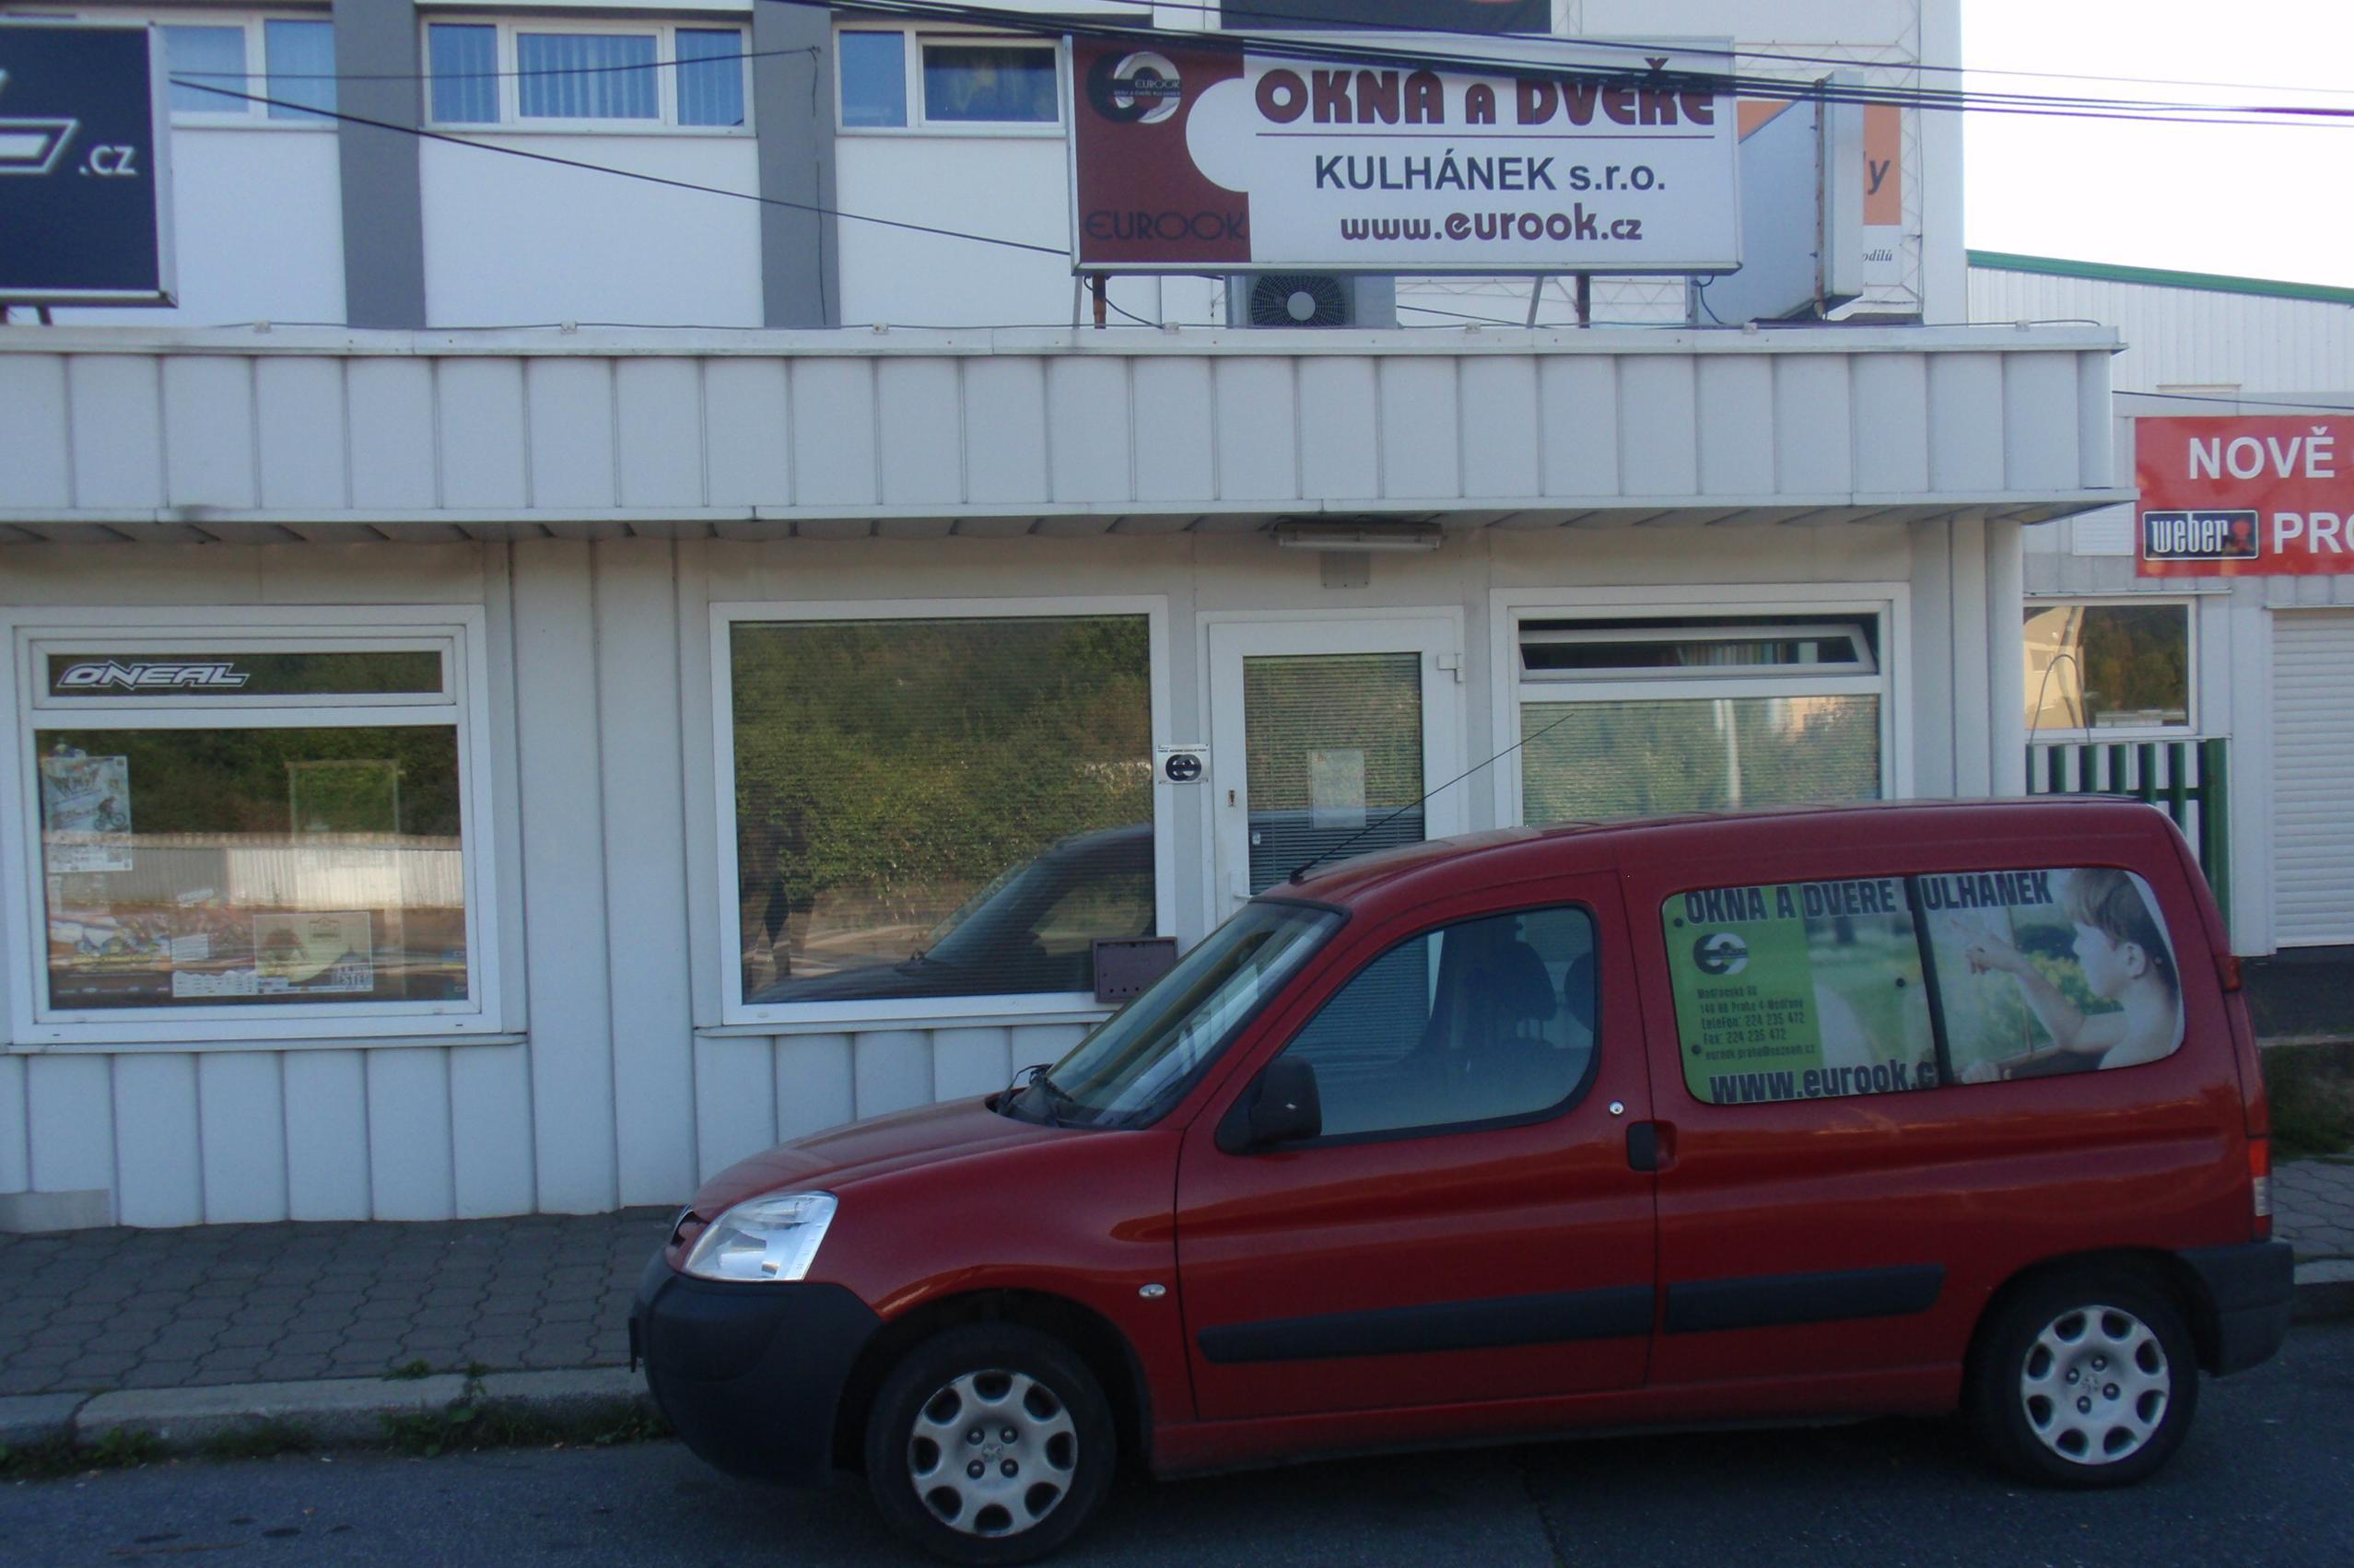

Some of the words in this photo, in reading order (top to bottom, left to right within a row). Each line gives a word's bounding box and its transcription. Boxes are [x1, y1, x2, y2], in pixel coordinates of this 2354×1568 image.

[1254, 67, 1445, 125] OKNA
[1315, 148, 1557, 191] KULHÁNEK
[1569, 164, 1666, 191] s.r.o.
[1085, 210, 1247, 241] EUROOK
[1340, 203, 1643, 241] www.eurook.cz
[2189, 426, 2336, 480] NOVĚ
[2150, 512, 2229, 554] weber
[2273, 512, 2354, 554] PR
[1684, 887, 1769, 924] OKNA
[1774, 885, 1798, 919] A
[1903, 871, 2054, 910] ULHANEK
[1710, 1059, 1940, 1104] www.eurook.c
